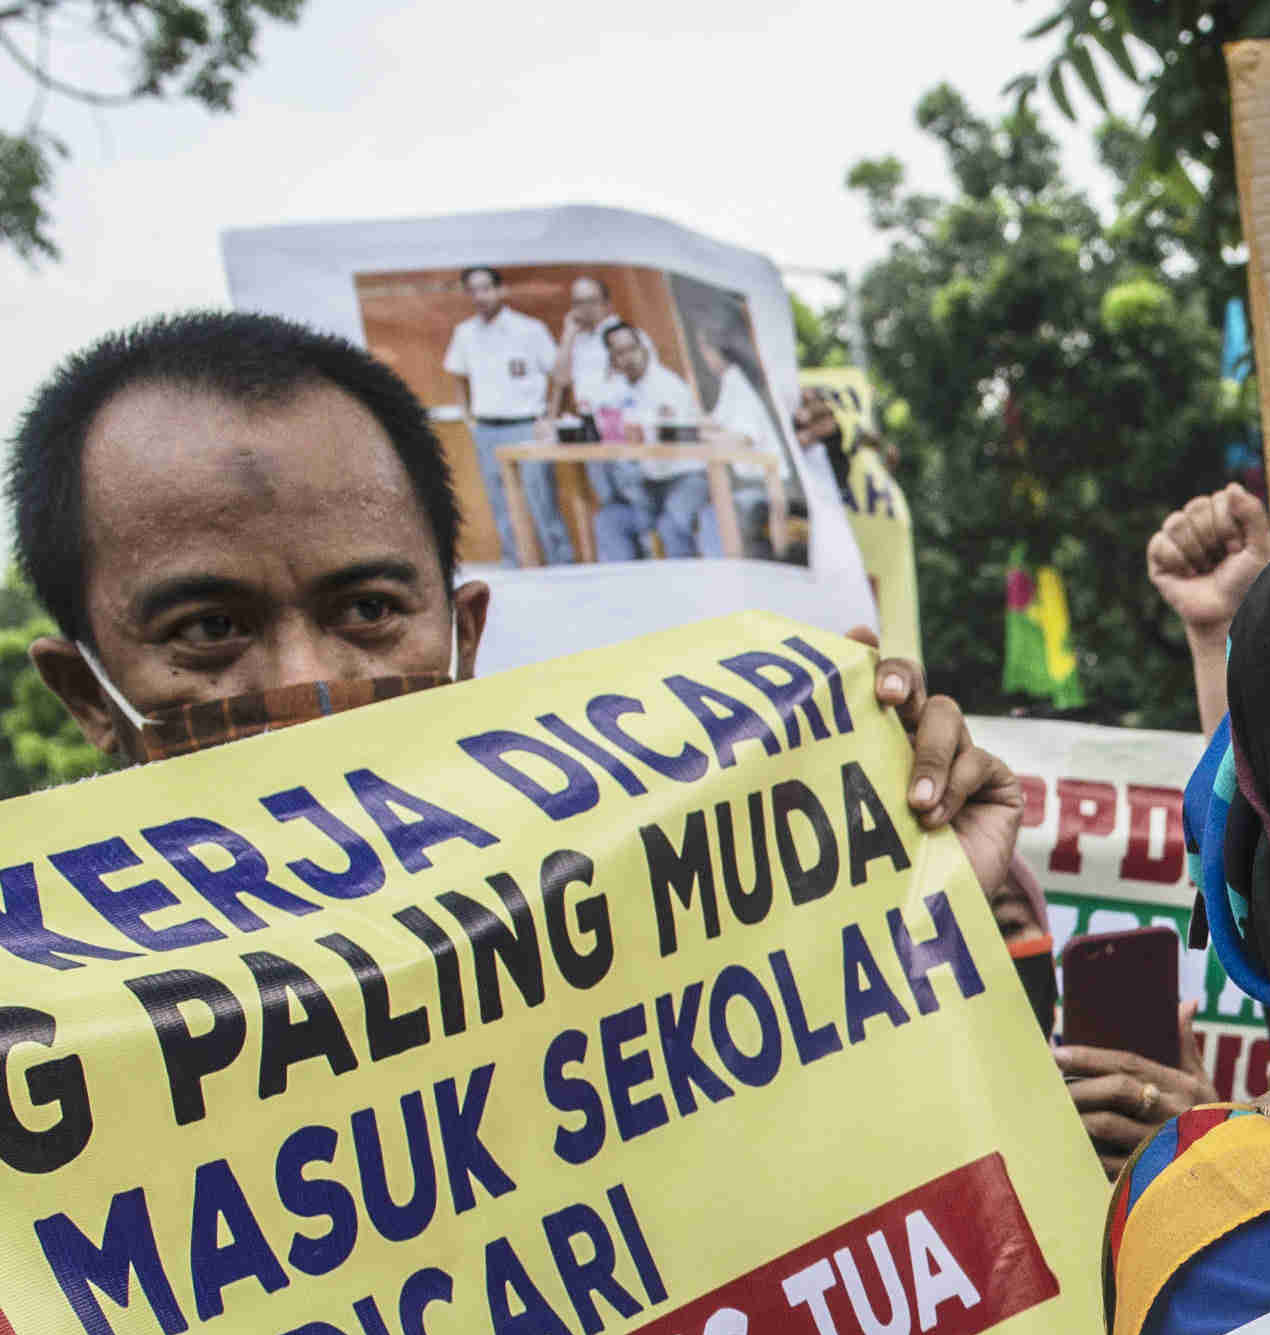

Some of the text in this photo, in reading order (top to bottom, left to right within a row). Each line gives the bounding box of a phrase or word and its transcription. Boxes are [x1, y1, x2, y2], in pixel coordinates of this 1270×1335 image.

[0, 637, 855, 971] KERJA DICARI
[124, 848, 614, 1127] PALING
[638, 760, 912, 958] MUDA
[543, 890, 987, 1165] SEKOLAH
